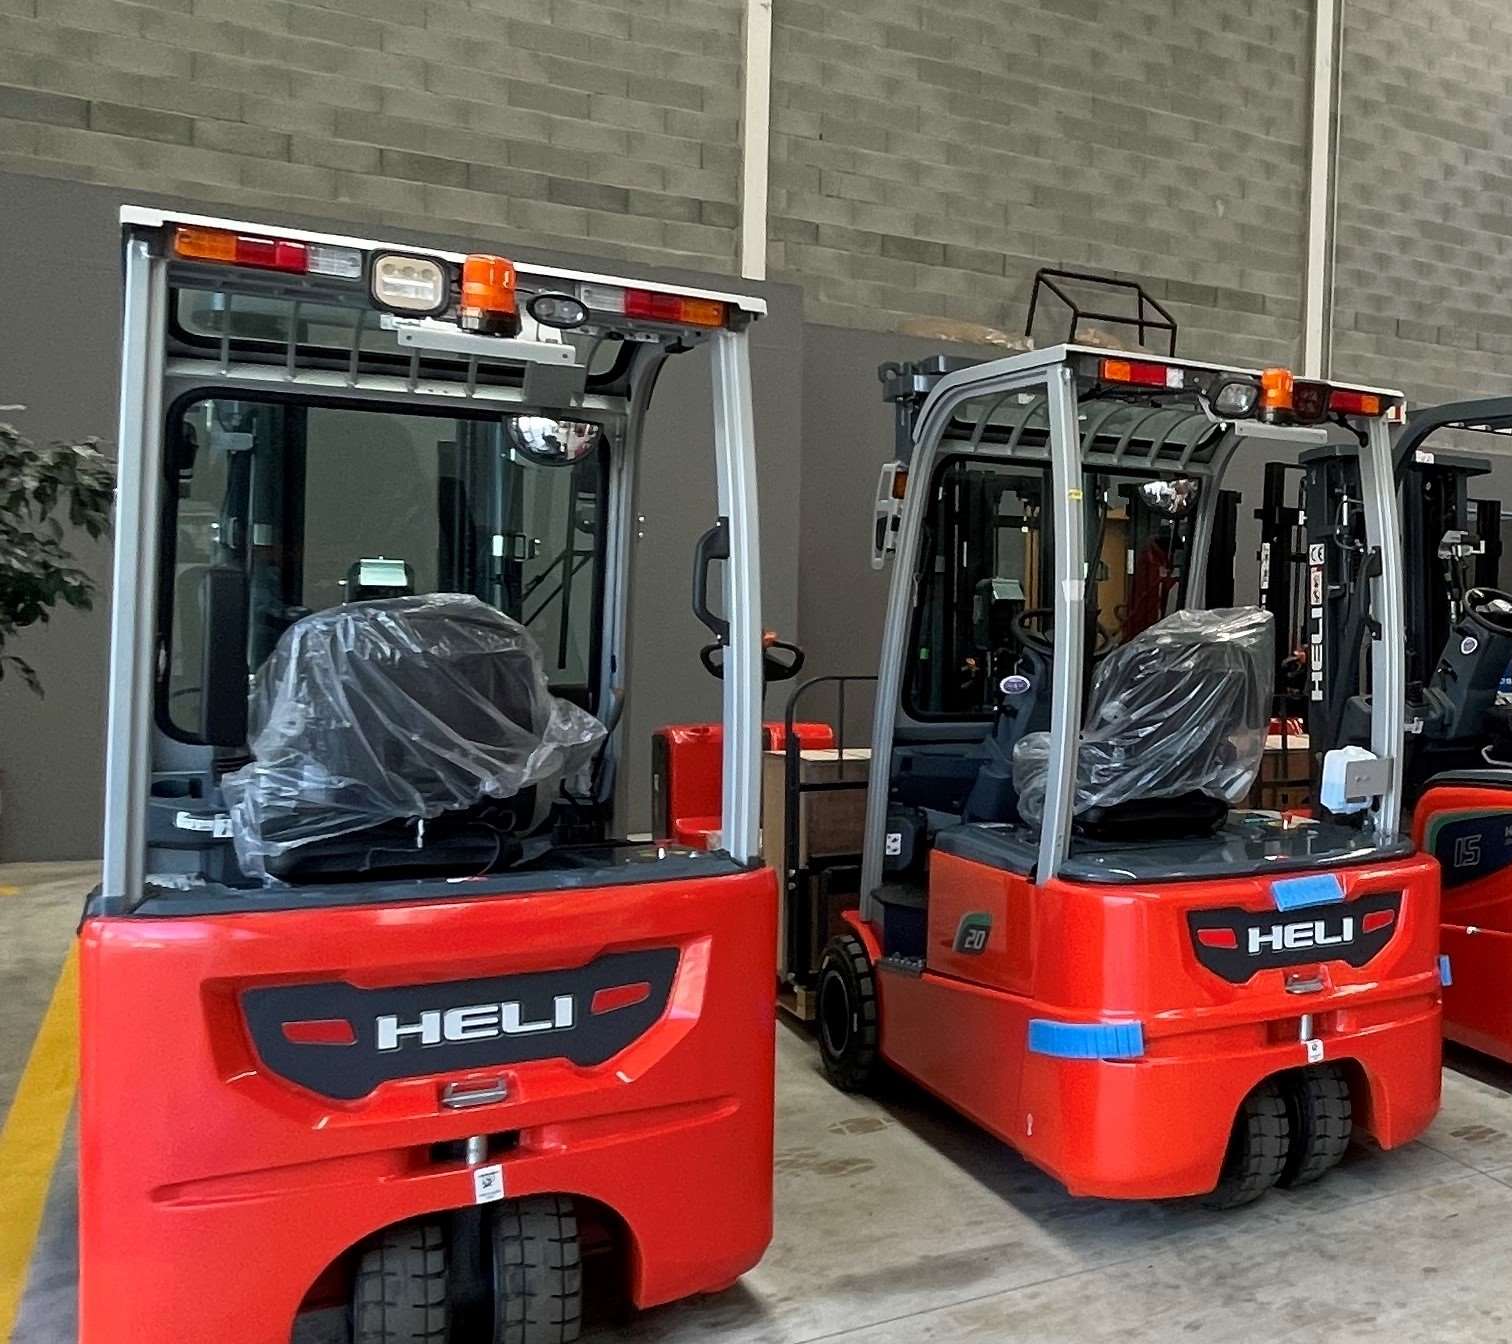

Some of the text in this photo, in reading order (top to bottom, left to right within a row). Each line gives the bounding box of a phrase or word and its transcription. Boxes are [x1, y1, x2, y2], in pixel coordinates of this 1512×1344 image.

[1311, 607, 1323, 701] HELI
[964, 928, 986, 950] 20
[1248, 917, 1354, 954] HELI
[376, 994, 574, 1051] HELI
